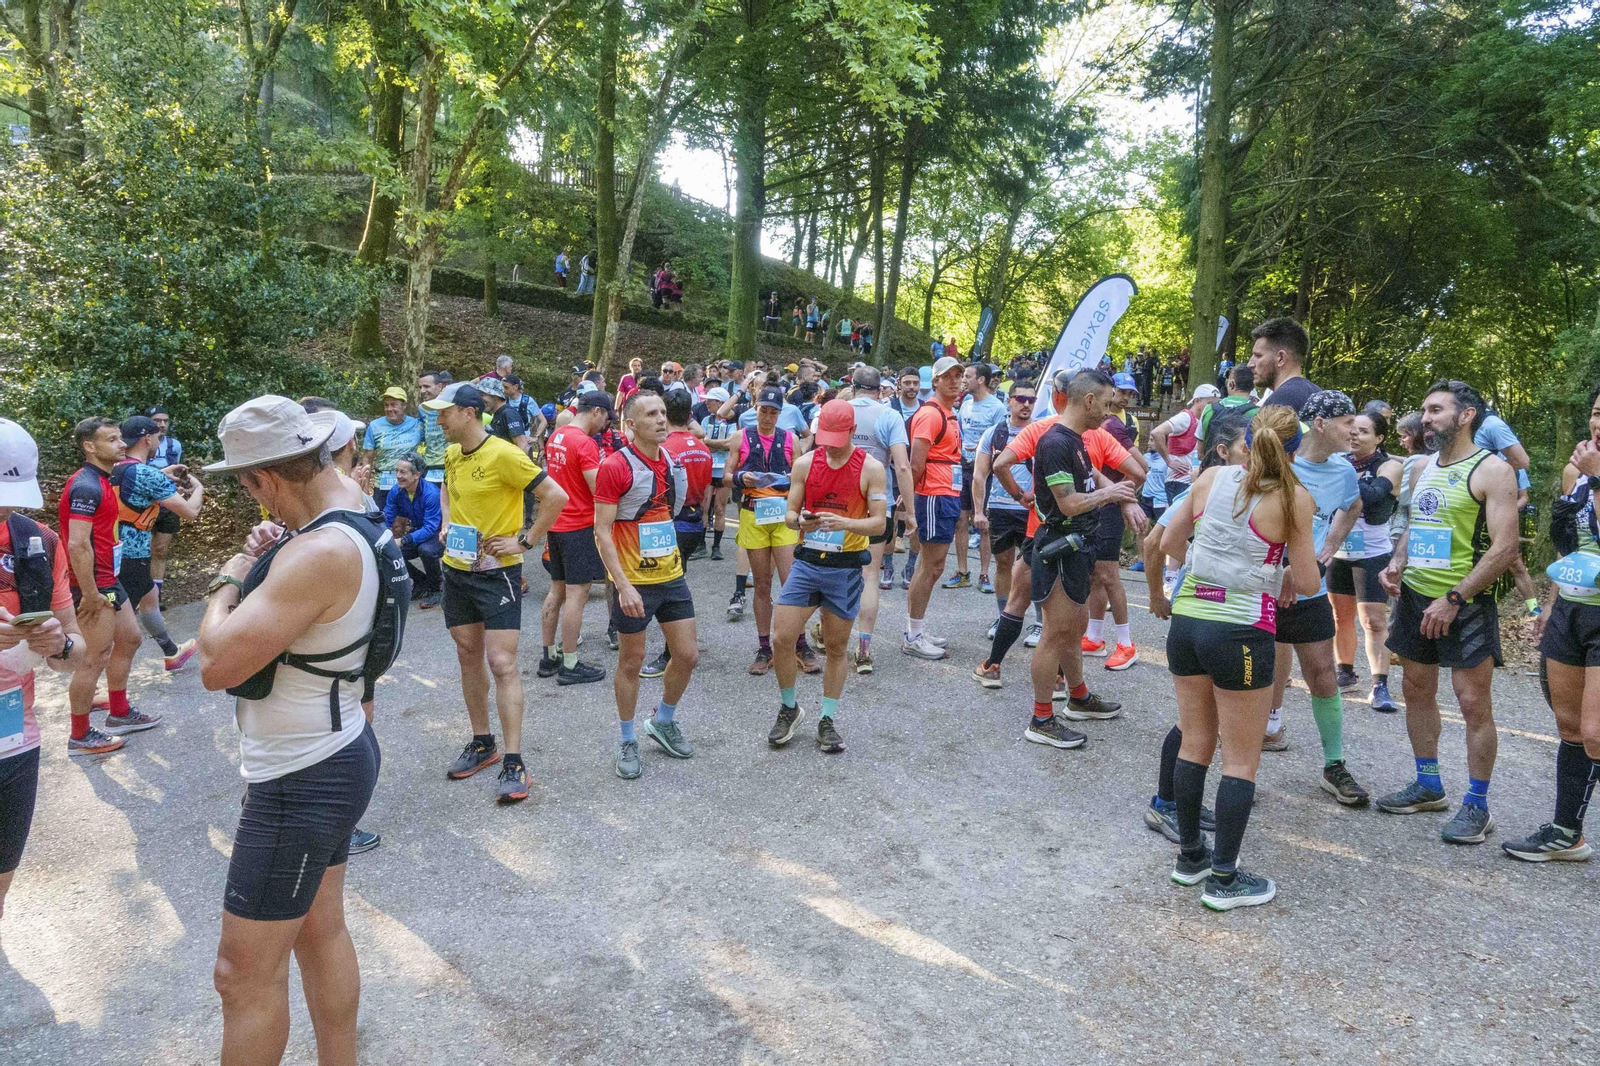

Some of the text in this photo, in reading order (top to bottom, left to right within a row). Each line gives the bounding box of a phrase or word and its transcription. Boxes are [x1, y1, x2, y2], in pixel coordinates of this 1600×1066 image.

[763, 506, 782, 517] 420
[451, 536, 465, 549] 173
[652, 534, 672, 548] 349
[812, 530, 834, 541] 347
[1411, 542, 1436, 556] 454
[1558, 566, 1583, 583] 283
[1243, 655, 1253, 686] TERREX
